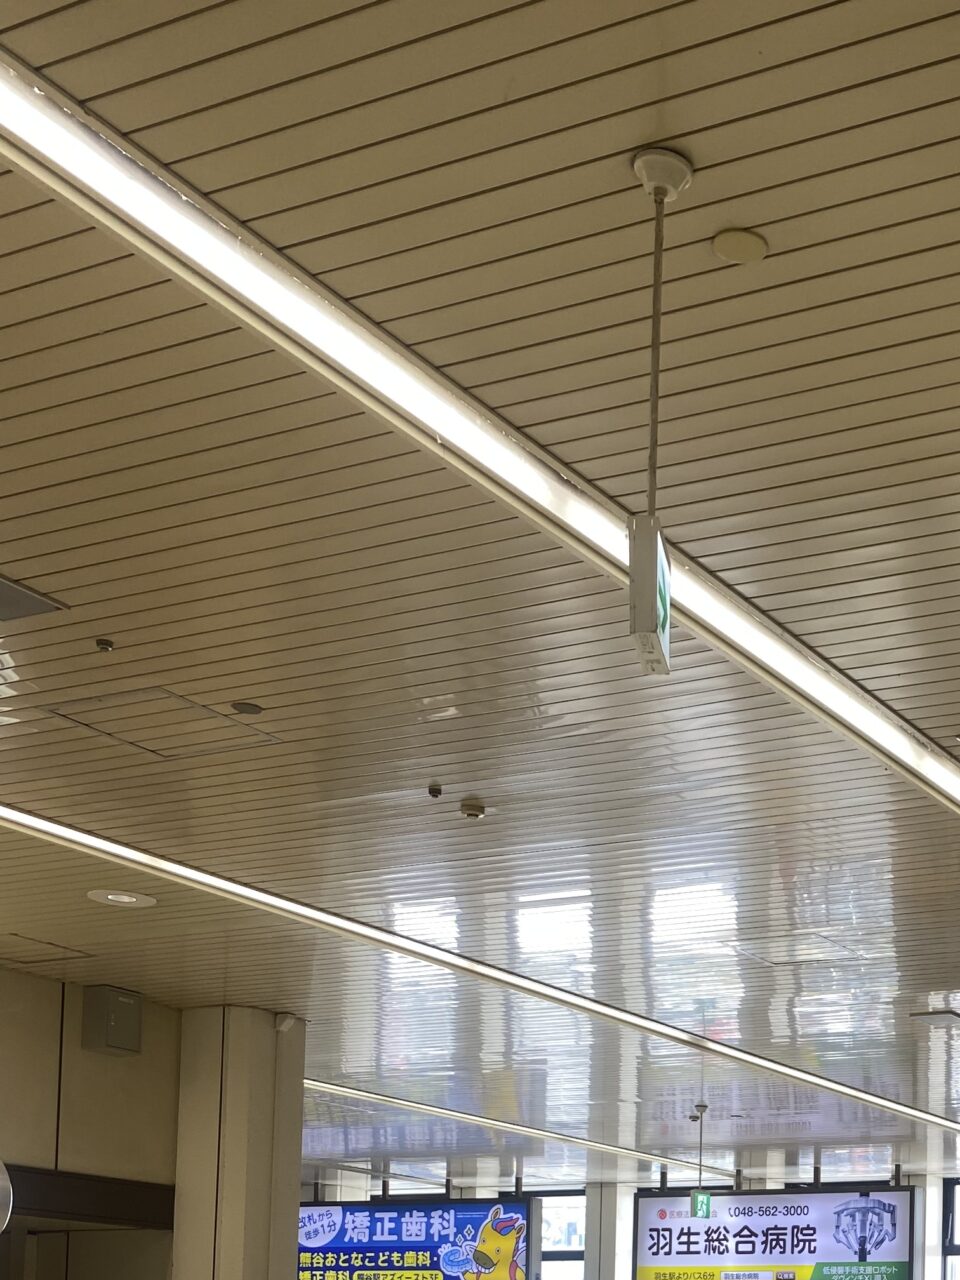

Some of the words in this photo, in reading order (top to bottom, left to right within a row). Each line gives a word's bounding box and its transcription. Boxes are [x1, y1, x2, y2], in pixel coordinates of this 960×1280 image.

[298, 1210, 333, 1229] 改札から
[734, 1206, 809, 1218] 048-562-3000
[304, 1220, 337, 1240] 徒歩1分
[344, 1209, 457, 1244] 矯正歯科
[648, 1224, 817, 1256] 羽生総合病院
[654, 1272, 715, 1280] 羽生駅よりバス6分
